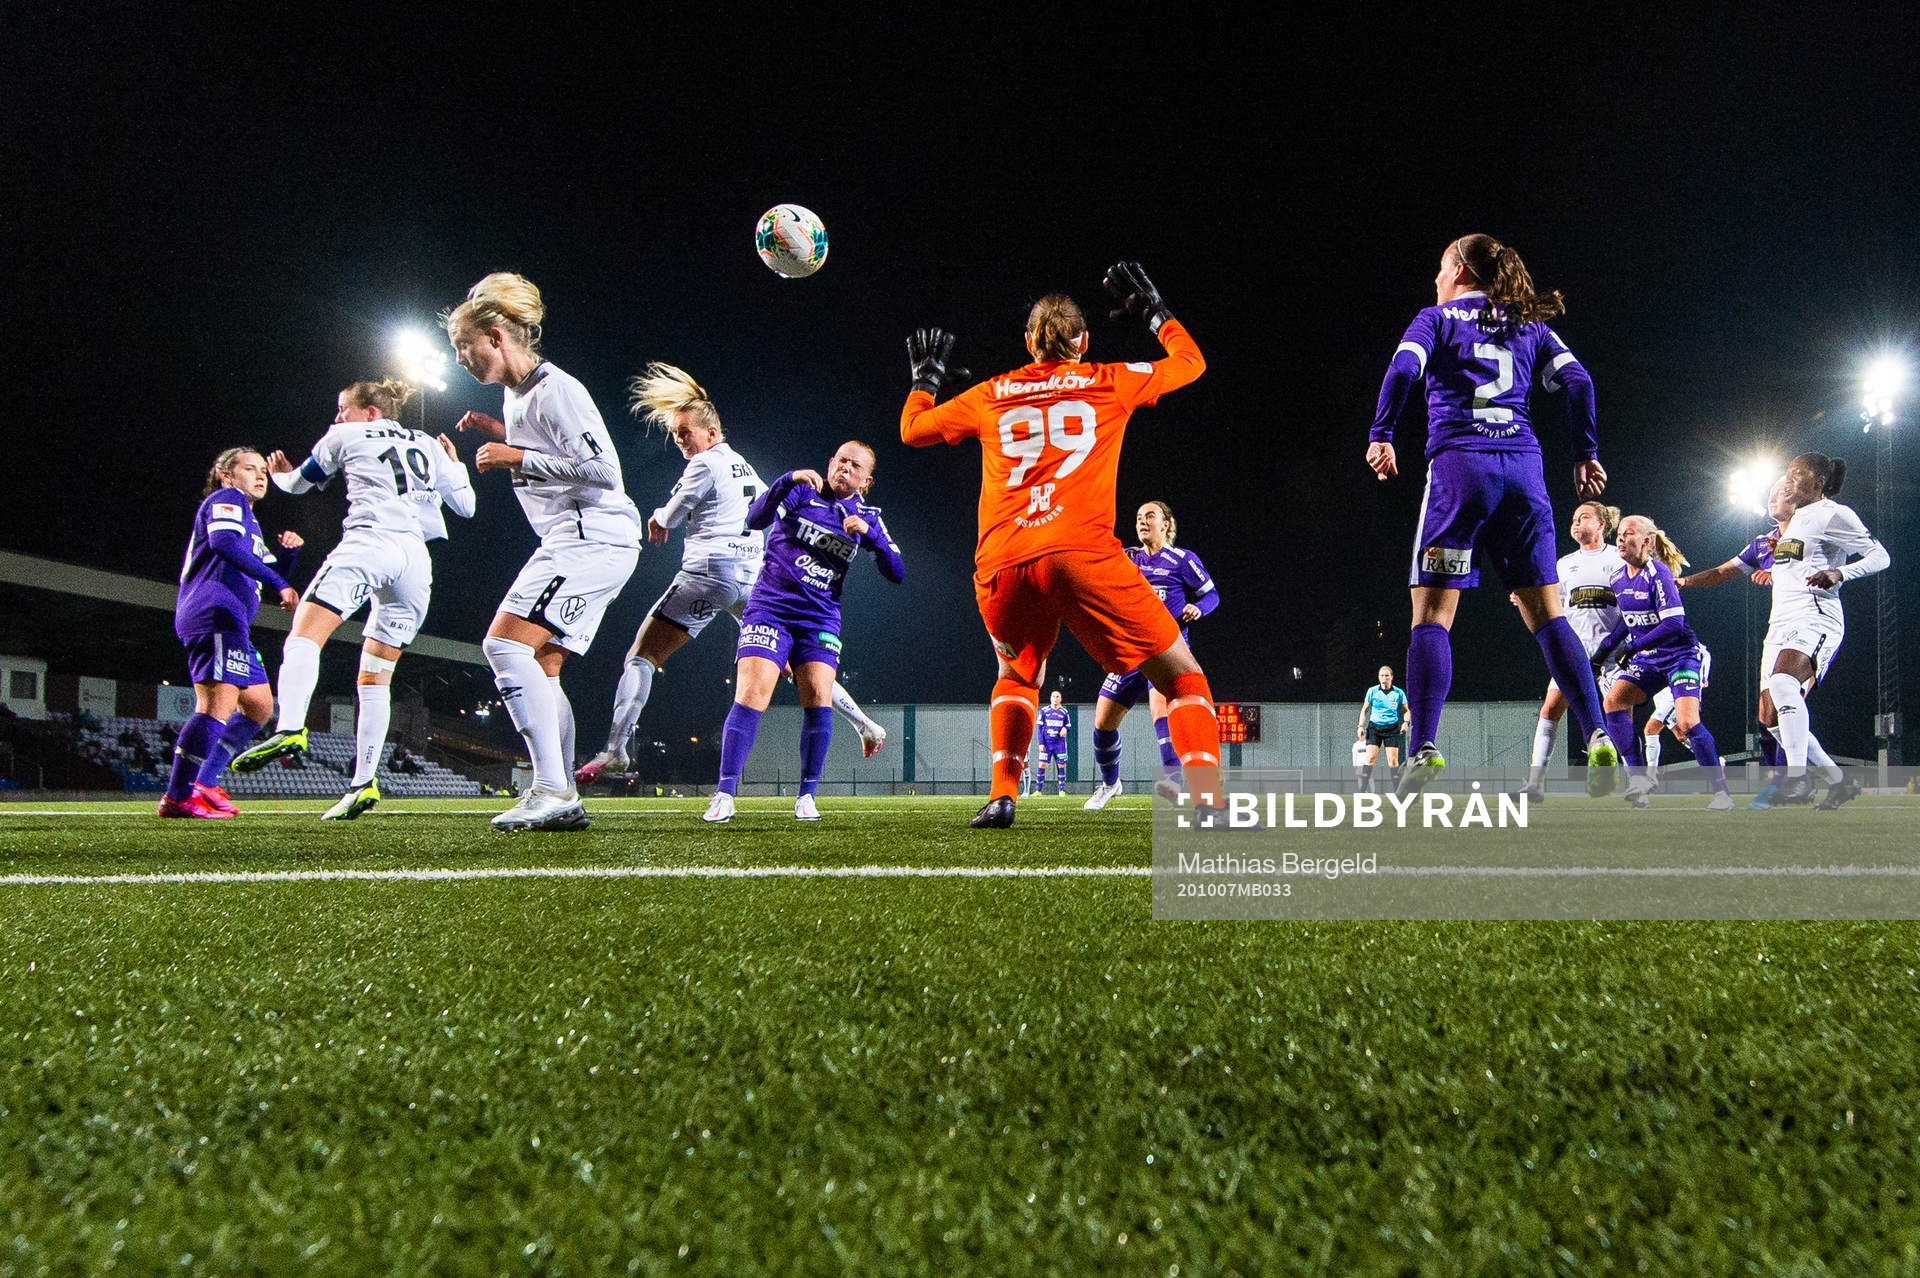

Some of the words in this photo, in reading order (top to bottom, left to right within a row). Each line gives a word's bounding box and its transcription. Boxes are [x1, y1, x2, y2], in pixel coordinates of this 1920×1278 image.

[1473, 342, 1514, 421] 2
[377, 446, 431, 496] 10
[998, 400, 1097, 487] 99
